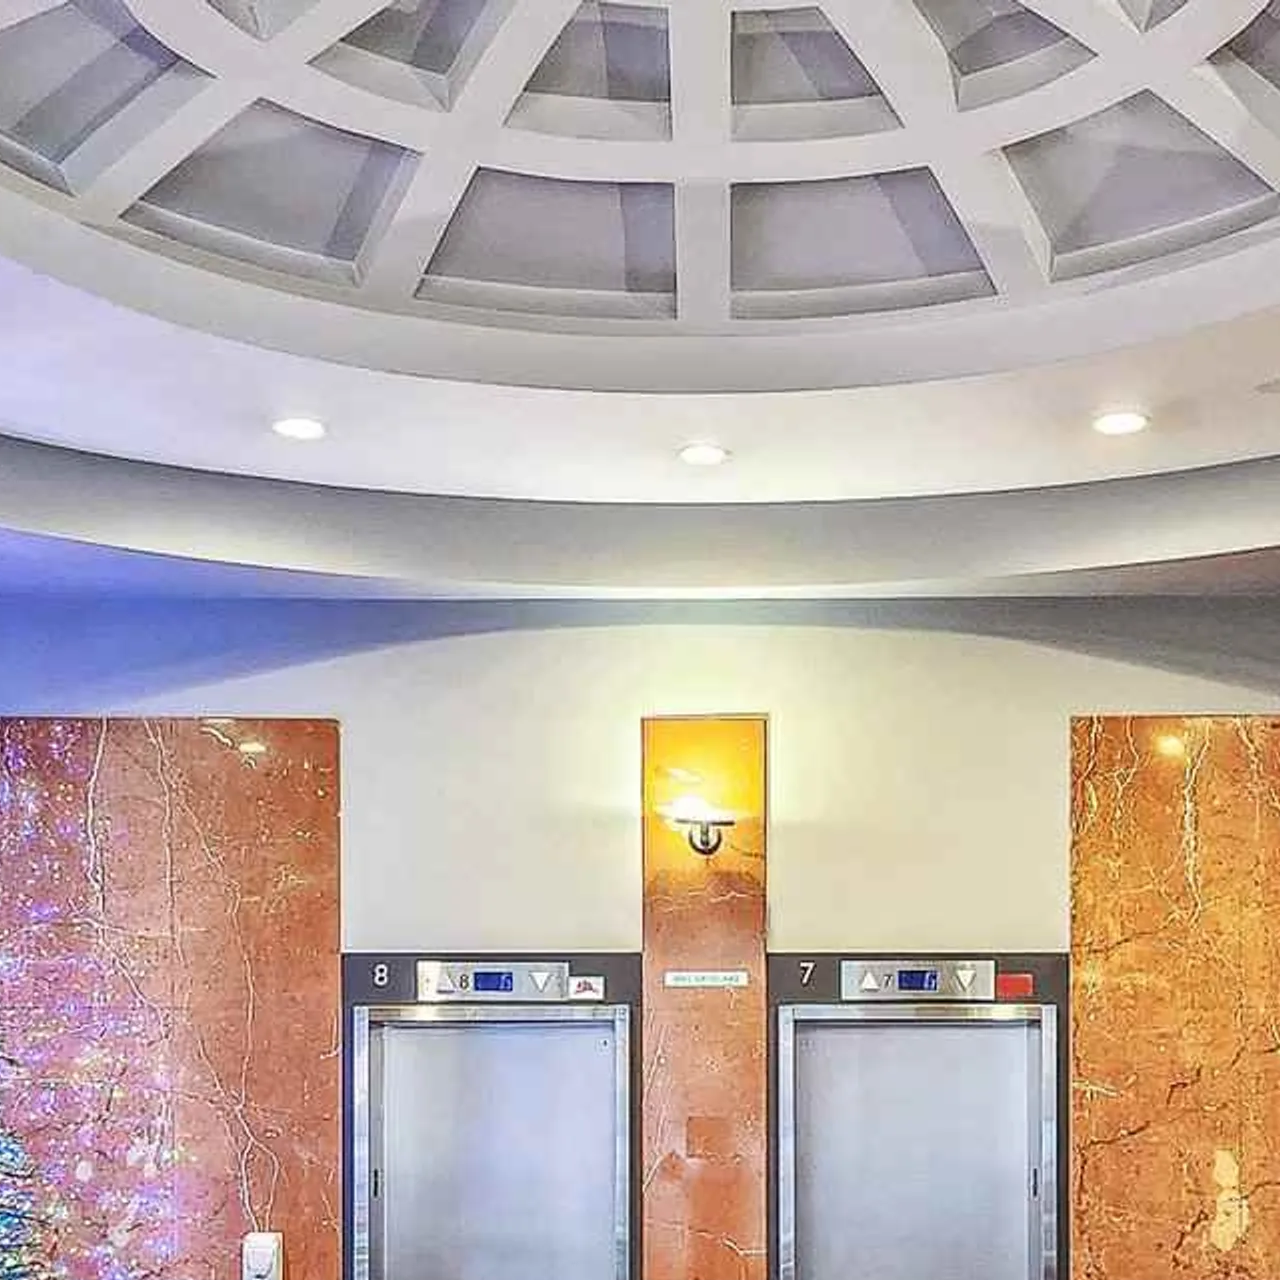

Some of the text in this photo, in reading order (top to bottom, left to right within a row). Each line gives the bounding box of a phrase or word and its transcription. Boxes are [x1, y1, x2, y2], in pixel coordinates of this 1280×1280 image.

[373, 963, 389, 986] 8
[458, 973, 469, 990] 8
[799, 961, 816, 985] 7
